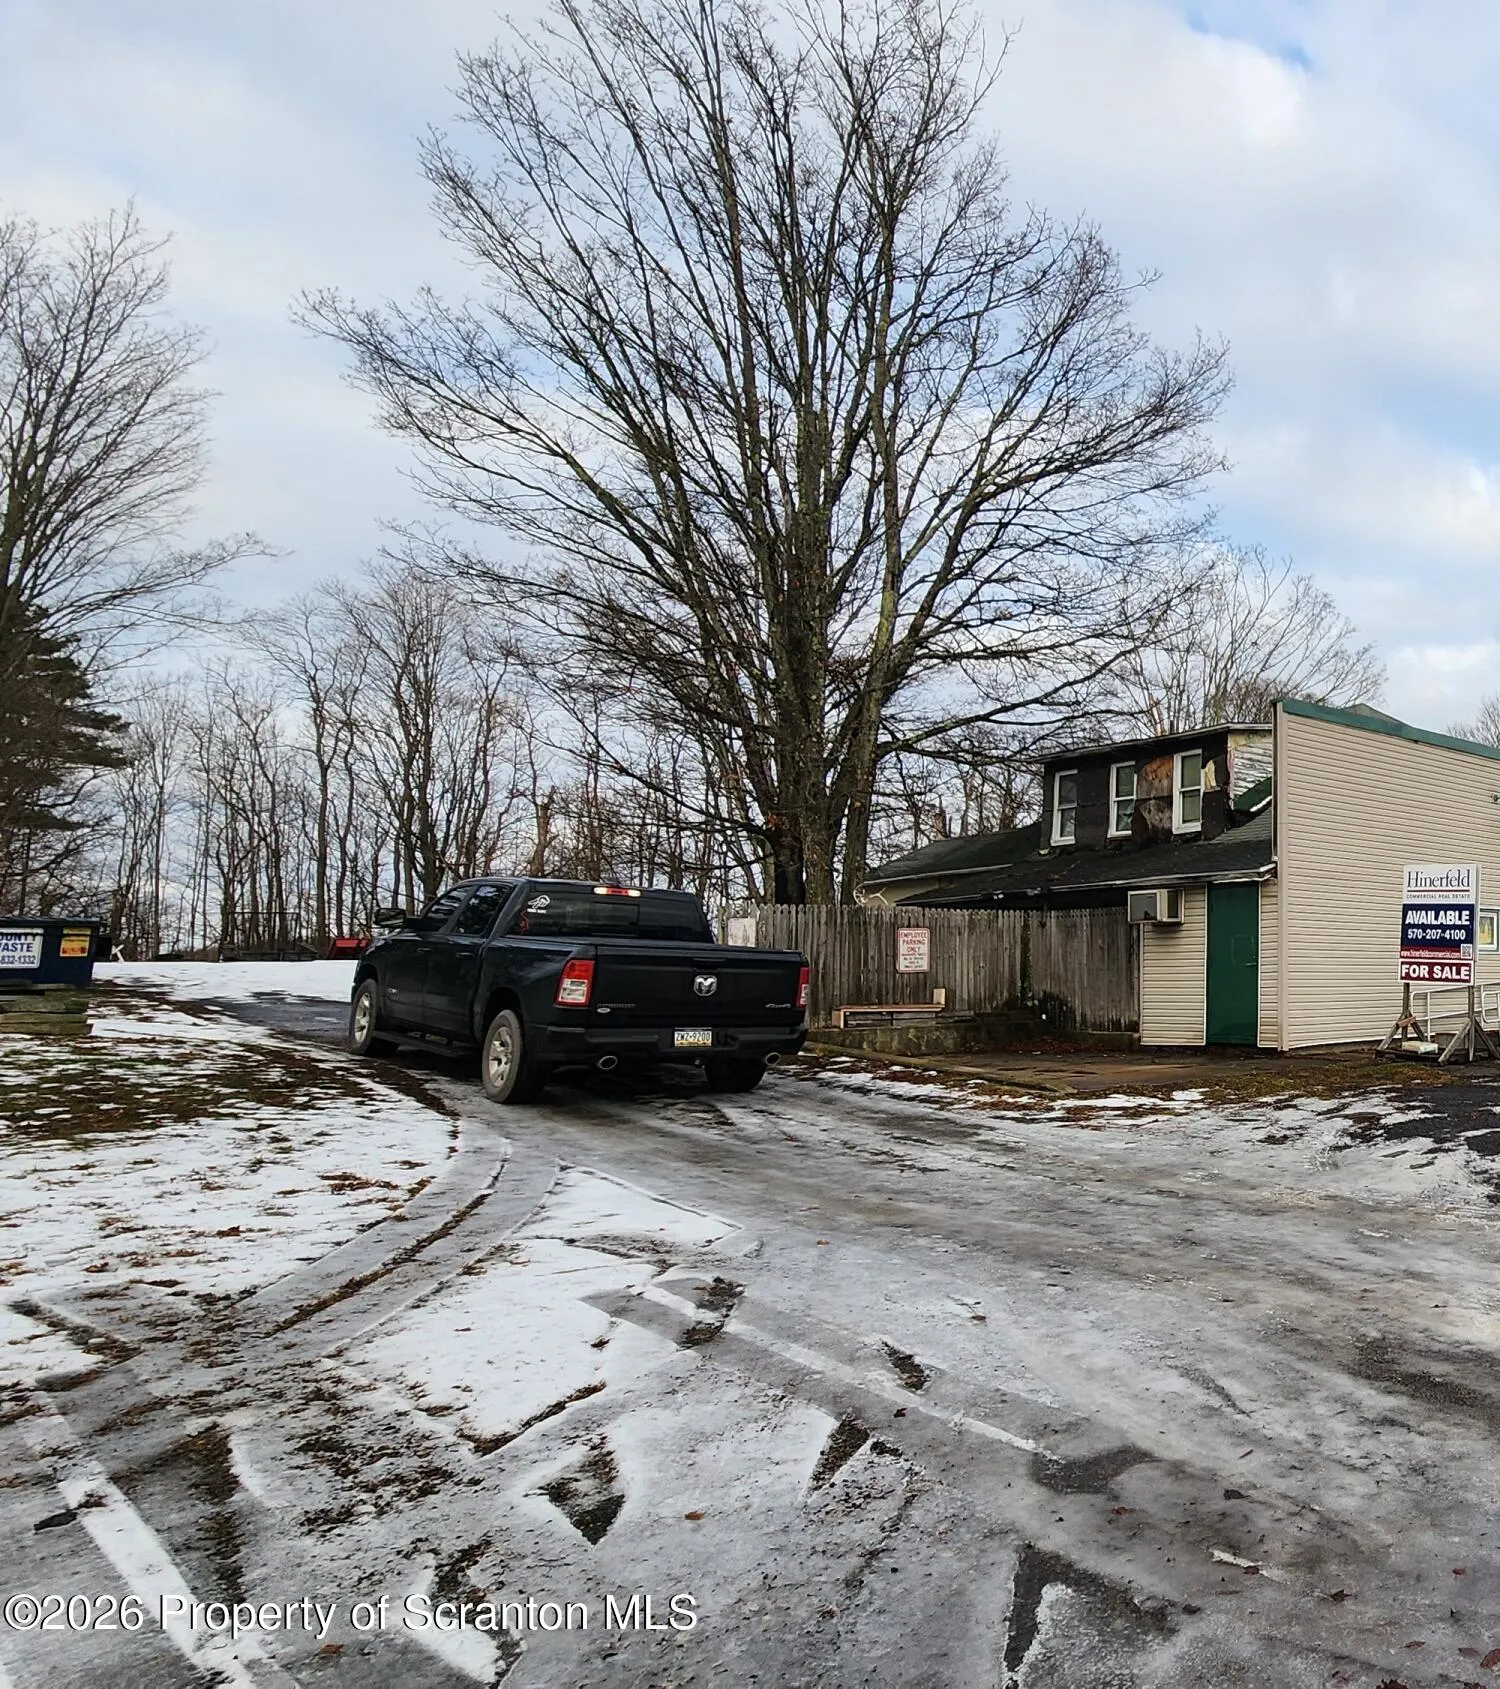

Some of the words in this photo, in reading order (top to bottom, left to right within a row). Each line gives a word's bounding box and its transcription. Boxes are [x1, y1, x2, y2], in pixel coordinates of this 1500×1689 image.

[1407, 868, 1470, 887] Hinerfeld
[1405, 910, 1470, 925] AVAILABLE
[1407, 928, 1466, 940] 570-207-4100
[1401, 964, 1429, 978] FOR
[1432, 965, 1470, 980] SALE
